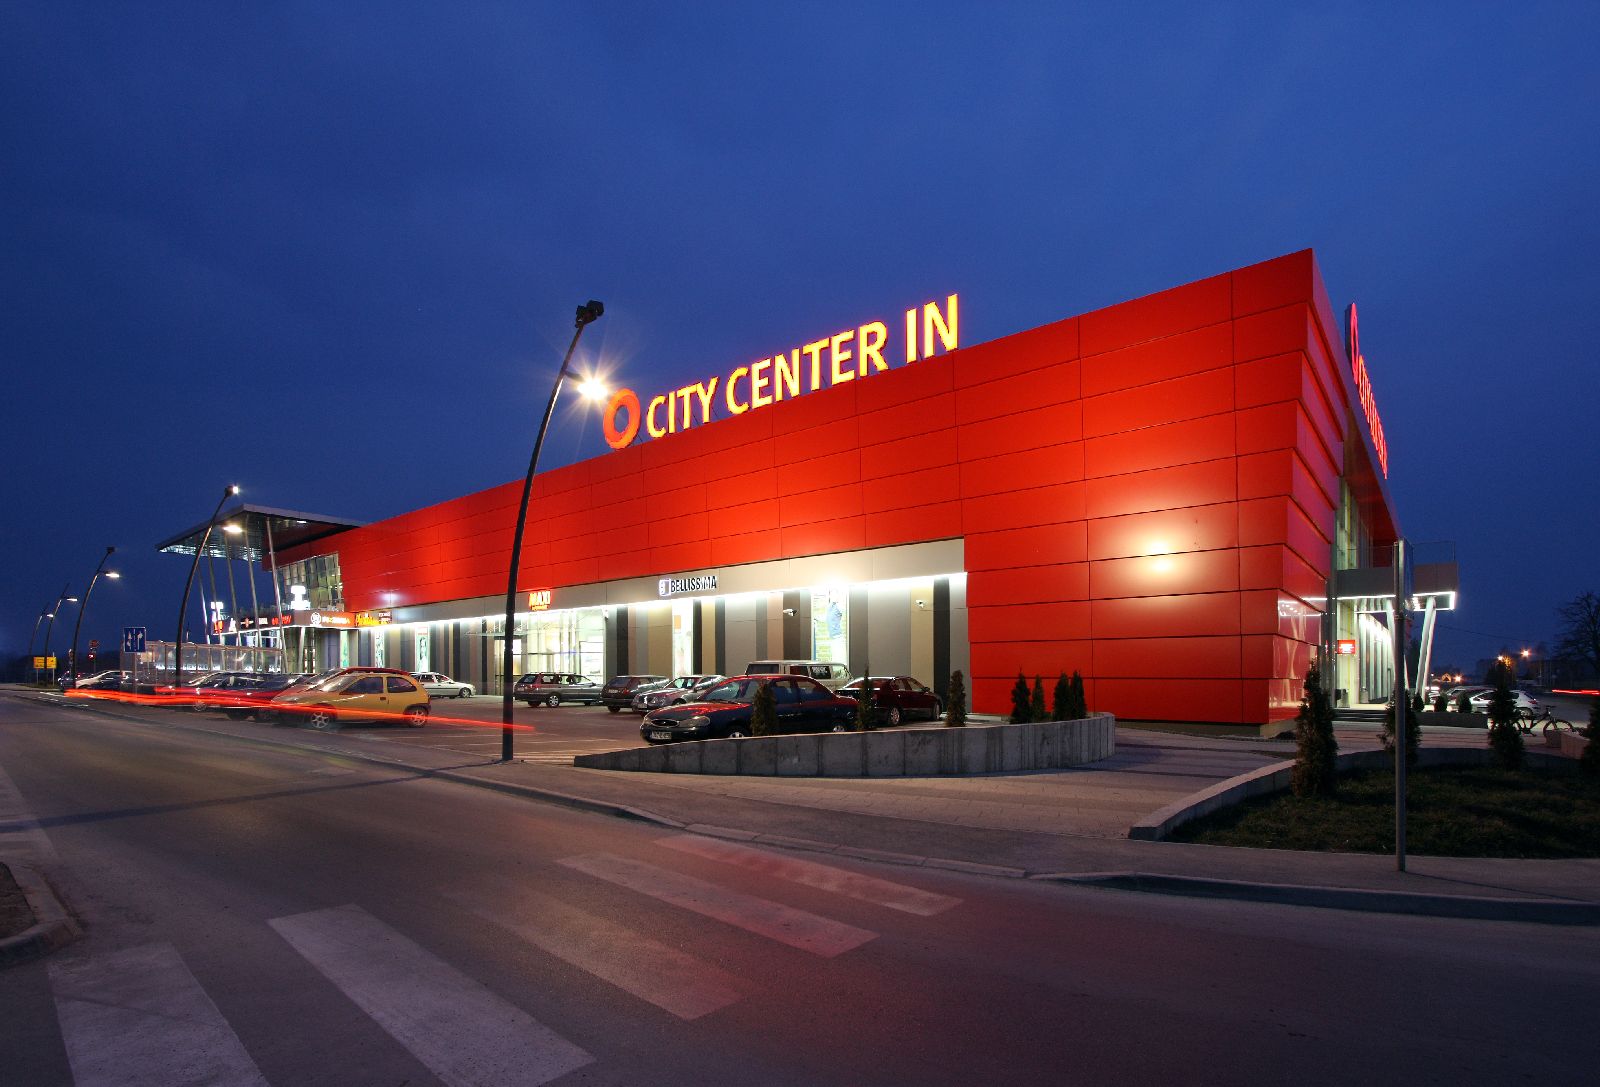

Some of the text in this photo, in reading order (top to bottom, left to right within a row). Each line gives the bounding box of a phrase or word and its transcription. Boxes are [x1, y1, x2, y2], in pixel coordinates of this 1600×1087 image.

[646, 377, 718, 438] CITY
[725, 320, 889, 415] CENTER
[905, 293, 958, 364] IN
[671, 576, 717, 593] BELLISSIMA
[529, 591, 551, 606] MAXI
